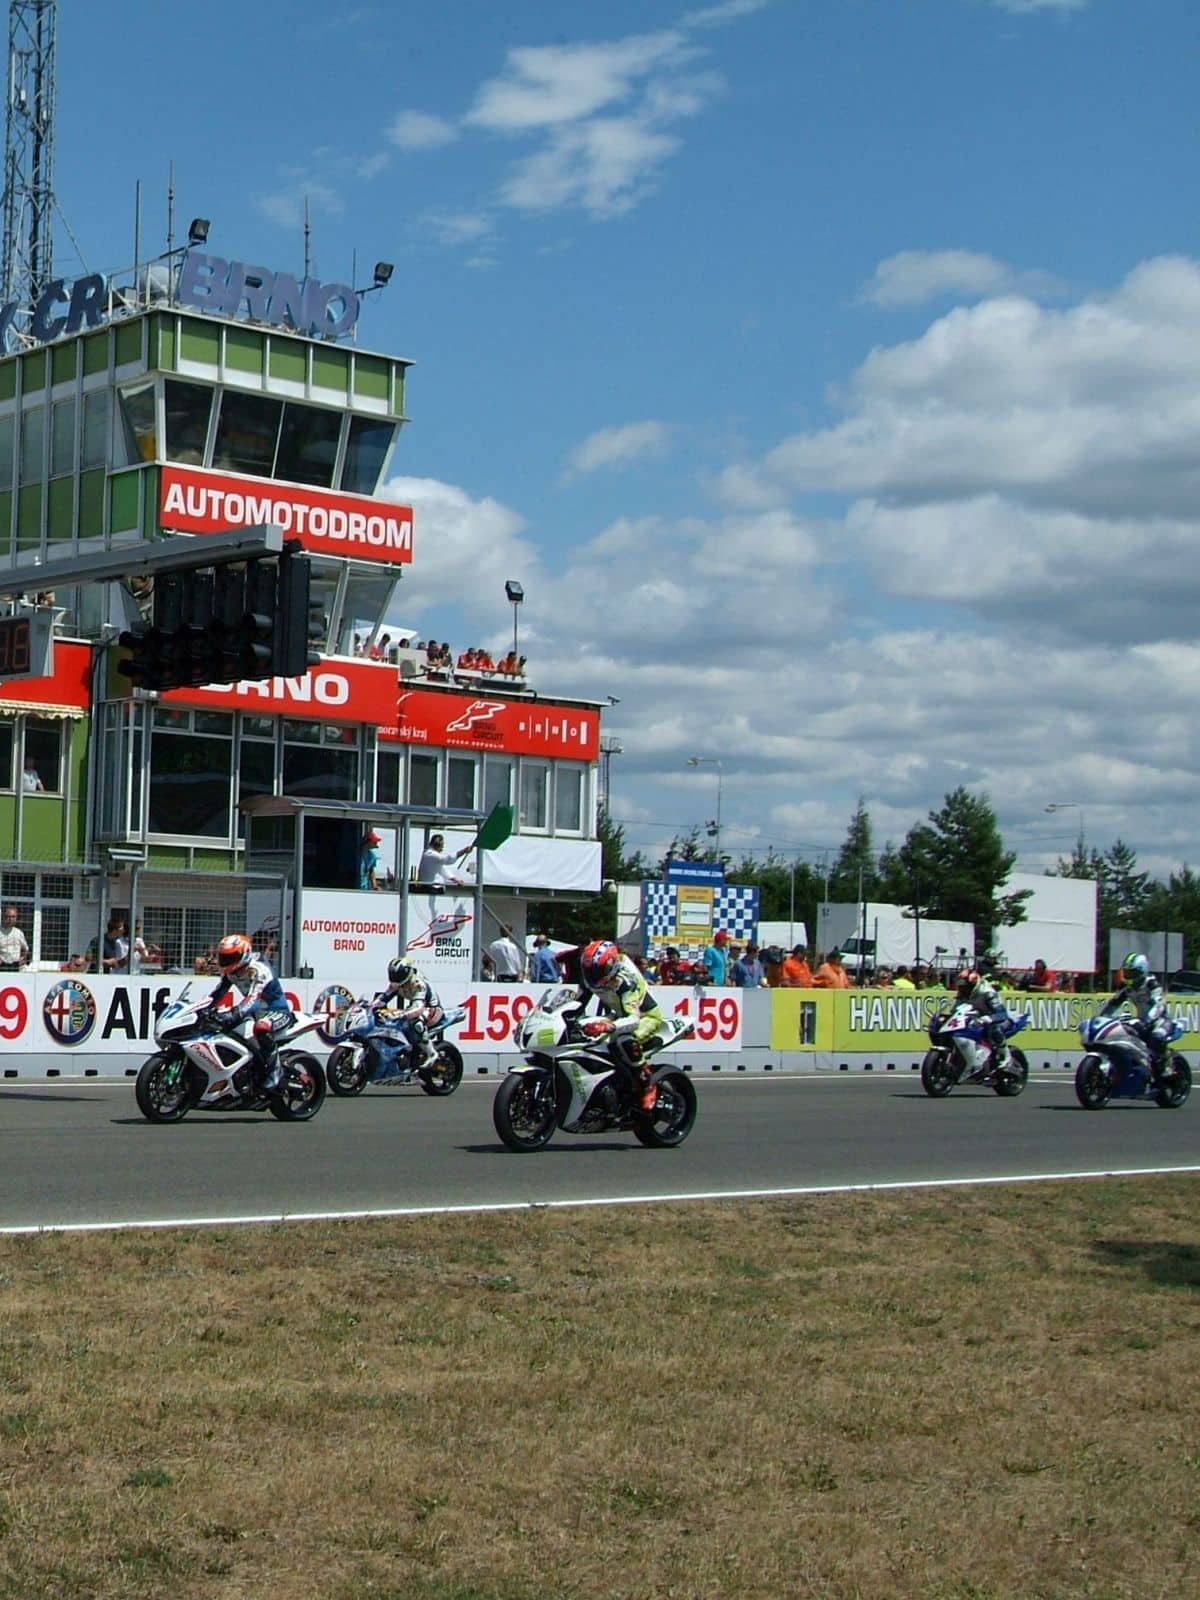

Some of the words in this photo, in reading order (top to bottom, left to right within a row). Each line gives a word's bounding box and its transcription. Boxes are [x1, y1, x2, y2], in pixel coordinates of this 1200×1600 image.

[180, 252, 361, 335] BRNO
[164, 483, 412, 551] AUTOMOTODROM
[200, 672, 349, 705] RNO
[302, 919, 397, 935] AUTOMOTODROM
[435, 937, 462, 947] BRNO
[333, 938, 365, 951] BRNO
[435, 948, 470, 958] CIRCUIT
[101, 987, 171, 1040] Alf
[675, 998, 738, 1041] 159
